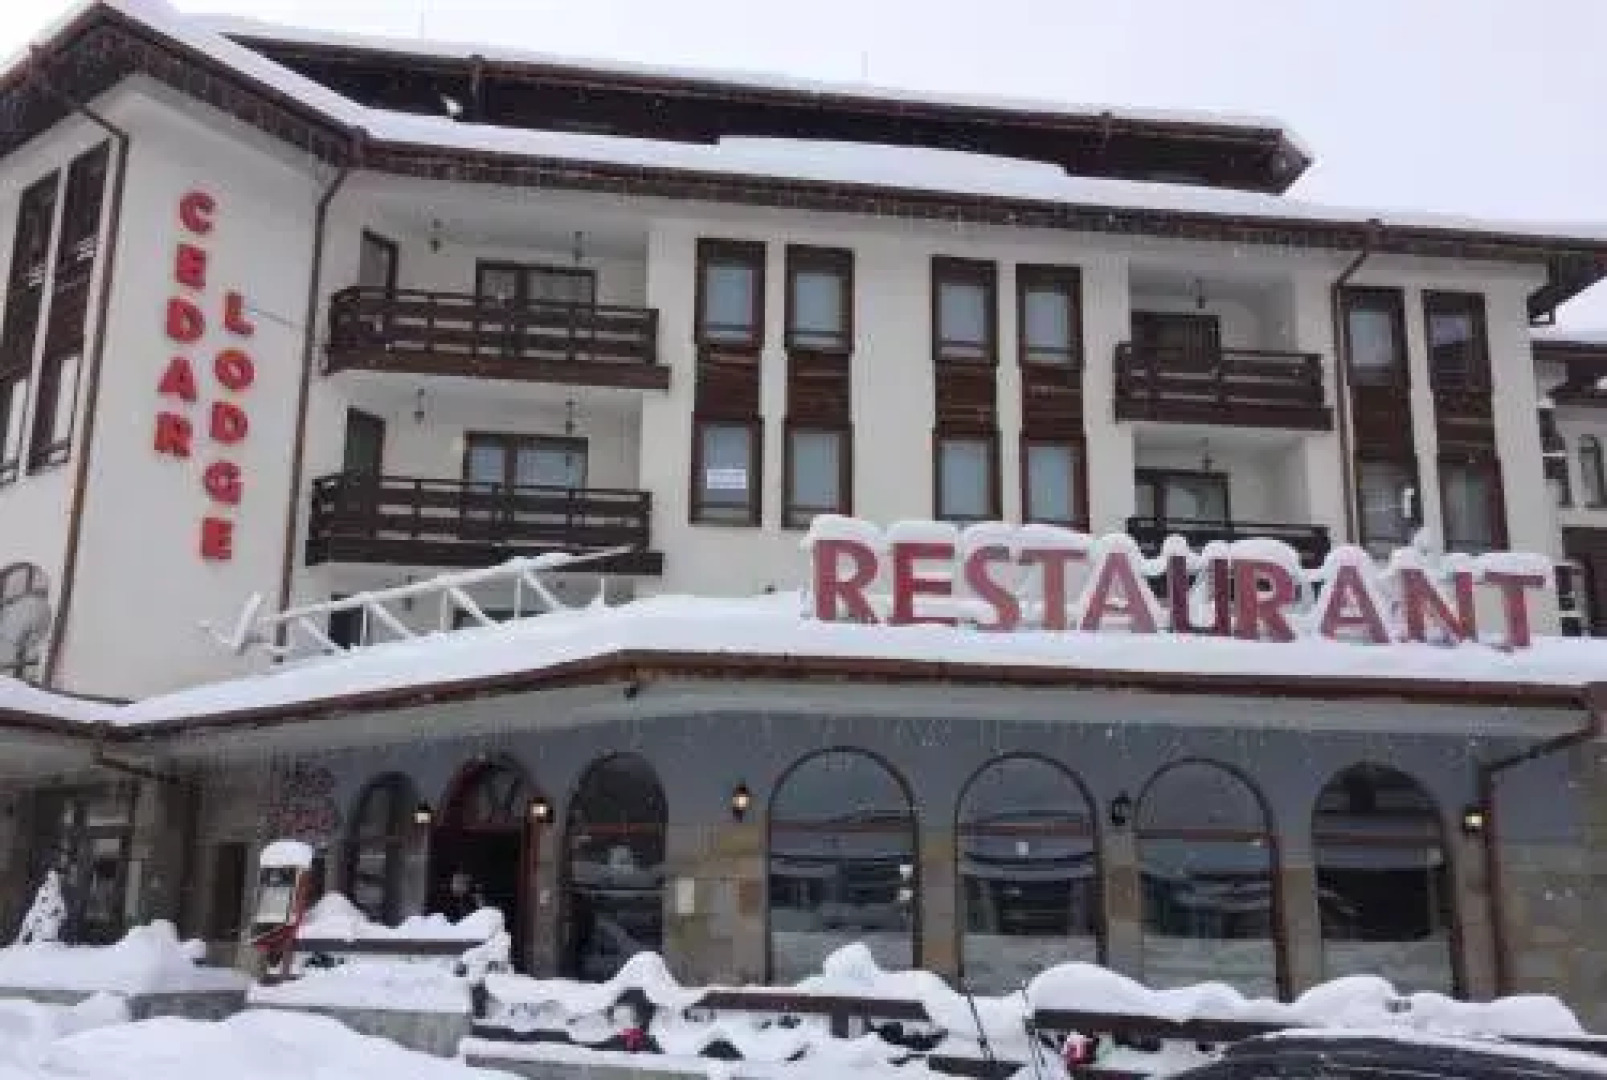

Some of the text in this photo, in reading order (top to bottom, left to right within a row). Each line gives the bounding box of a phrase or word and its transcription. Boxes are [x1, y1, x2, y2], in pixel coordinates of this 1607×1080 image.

[154, 191, 215, 457] CEDAR
[200, 291, 254, 560] LODGE
[813, 540, 1543, 647] RESTAURANT
